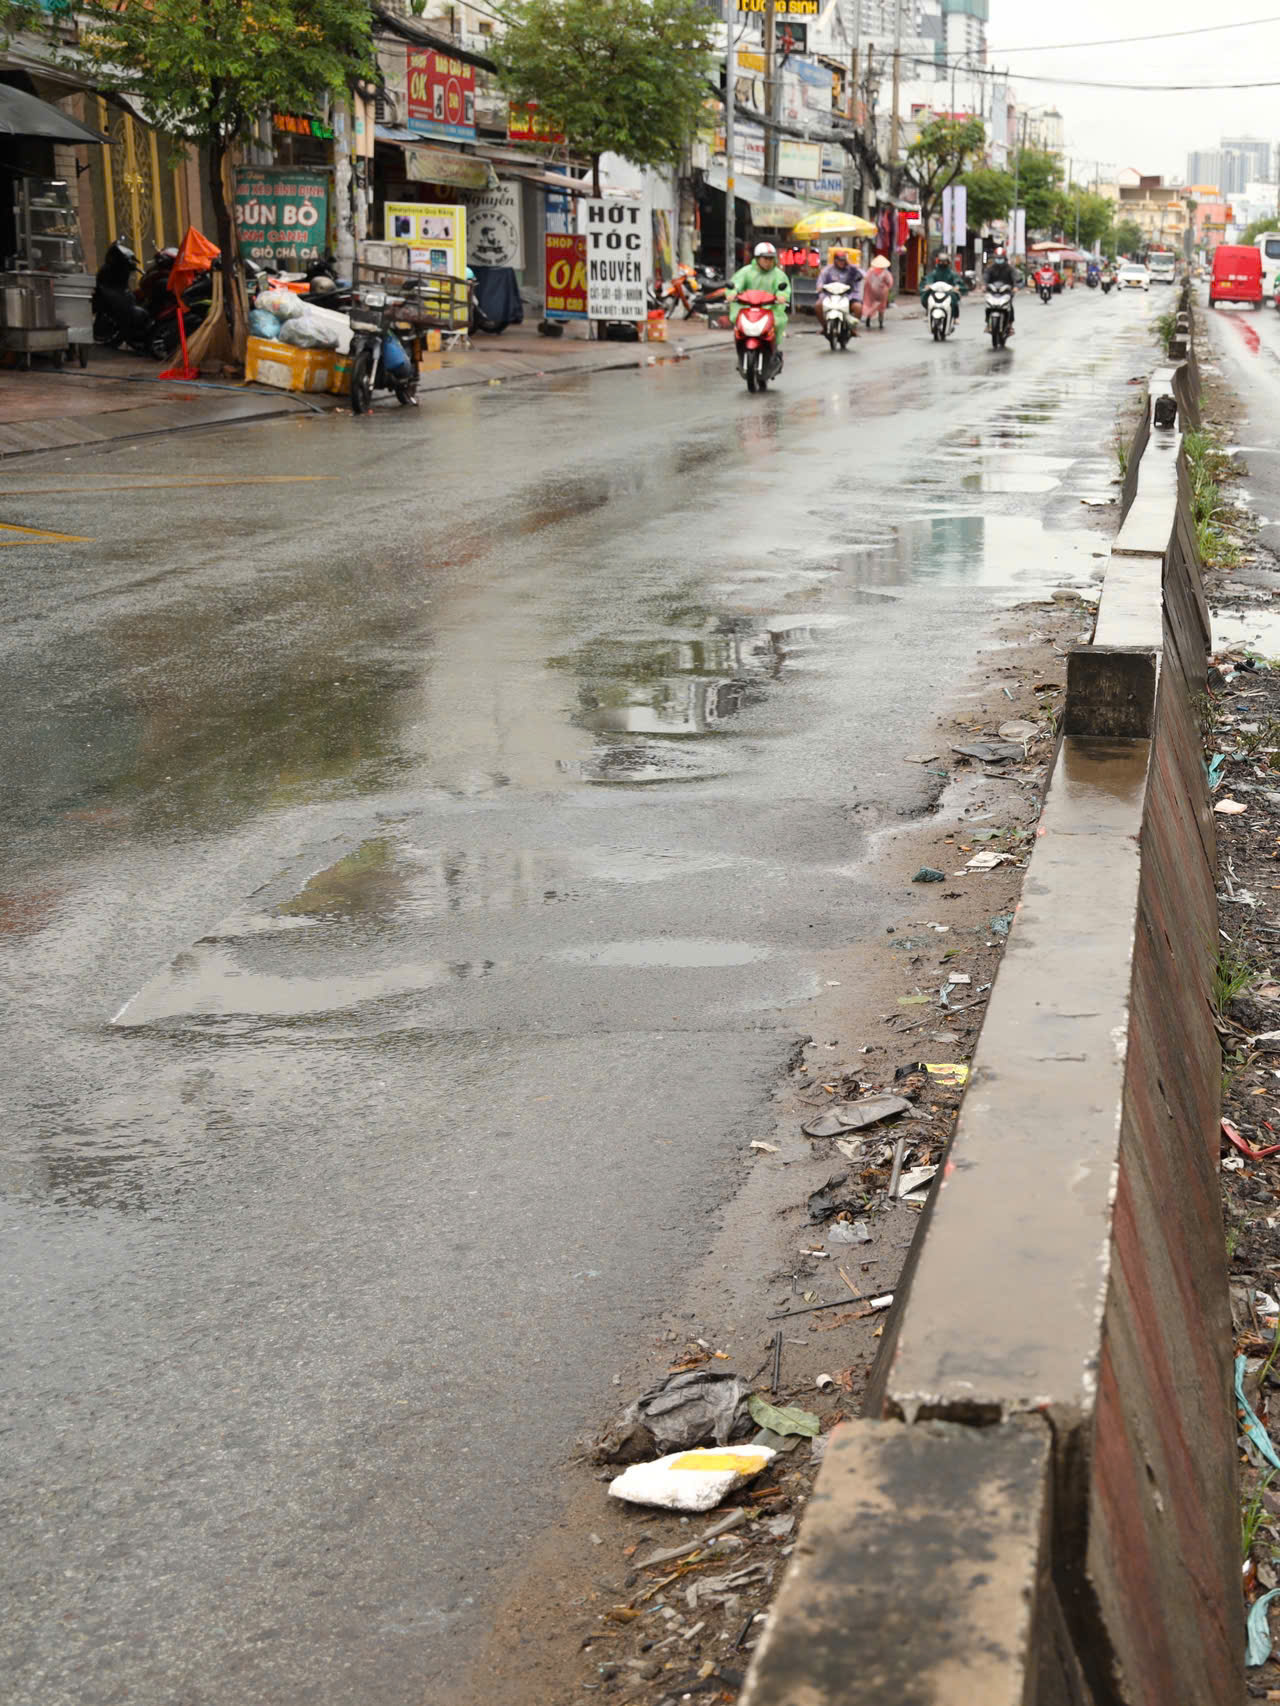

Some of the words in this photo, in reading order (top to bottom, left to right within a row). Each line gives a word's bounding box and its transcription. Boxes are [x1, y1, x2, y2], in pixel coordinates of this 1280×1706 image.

[411, 72, 427, 101] OK
[236, 199, 276, 225] BÚN
[283, 198, 318, 226] BÒ
[588, 203, 640, 224] HỚT
[267, 231, 308, 243] CANH
[546, 236, 573, 249] SHOP
[589, 229, 641, 250] TÓC
